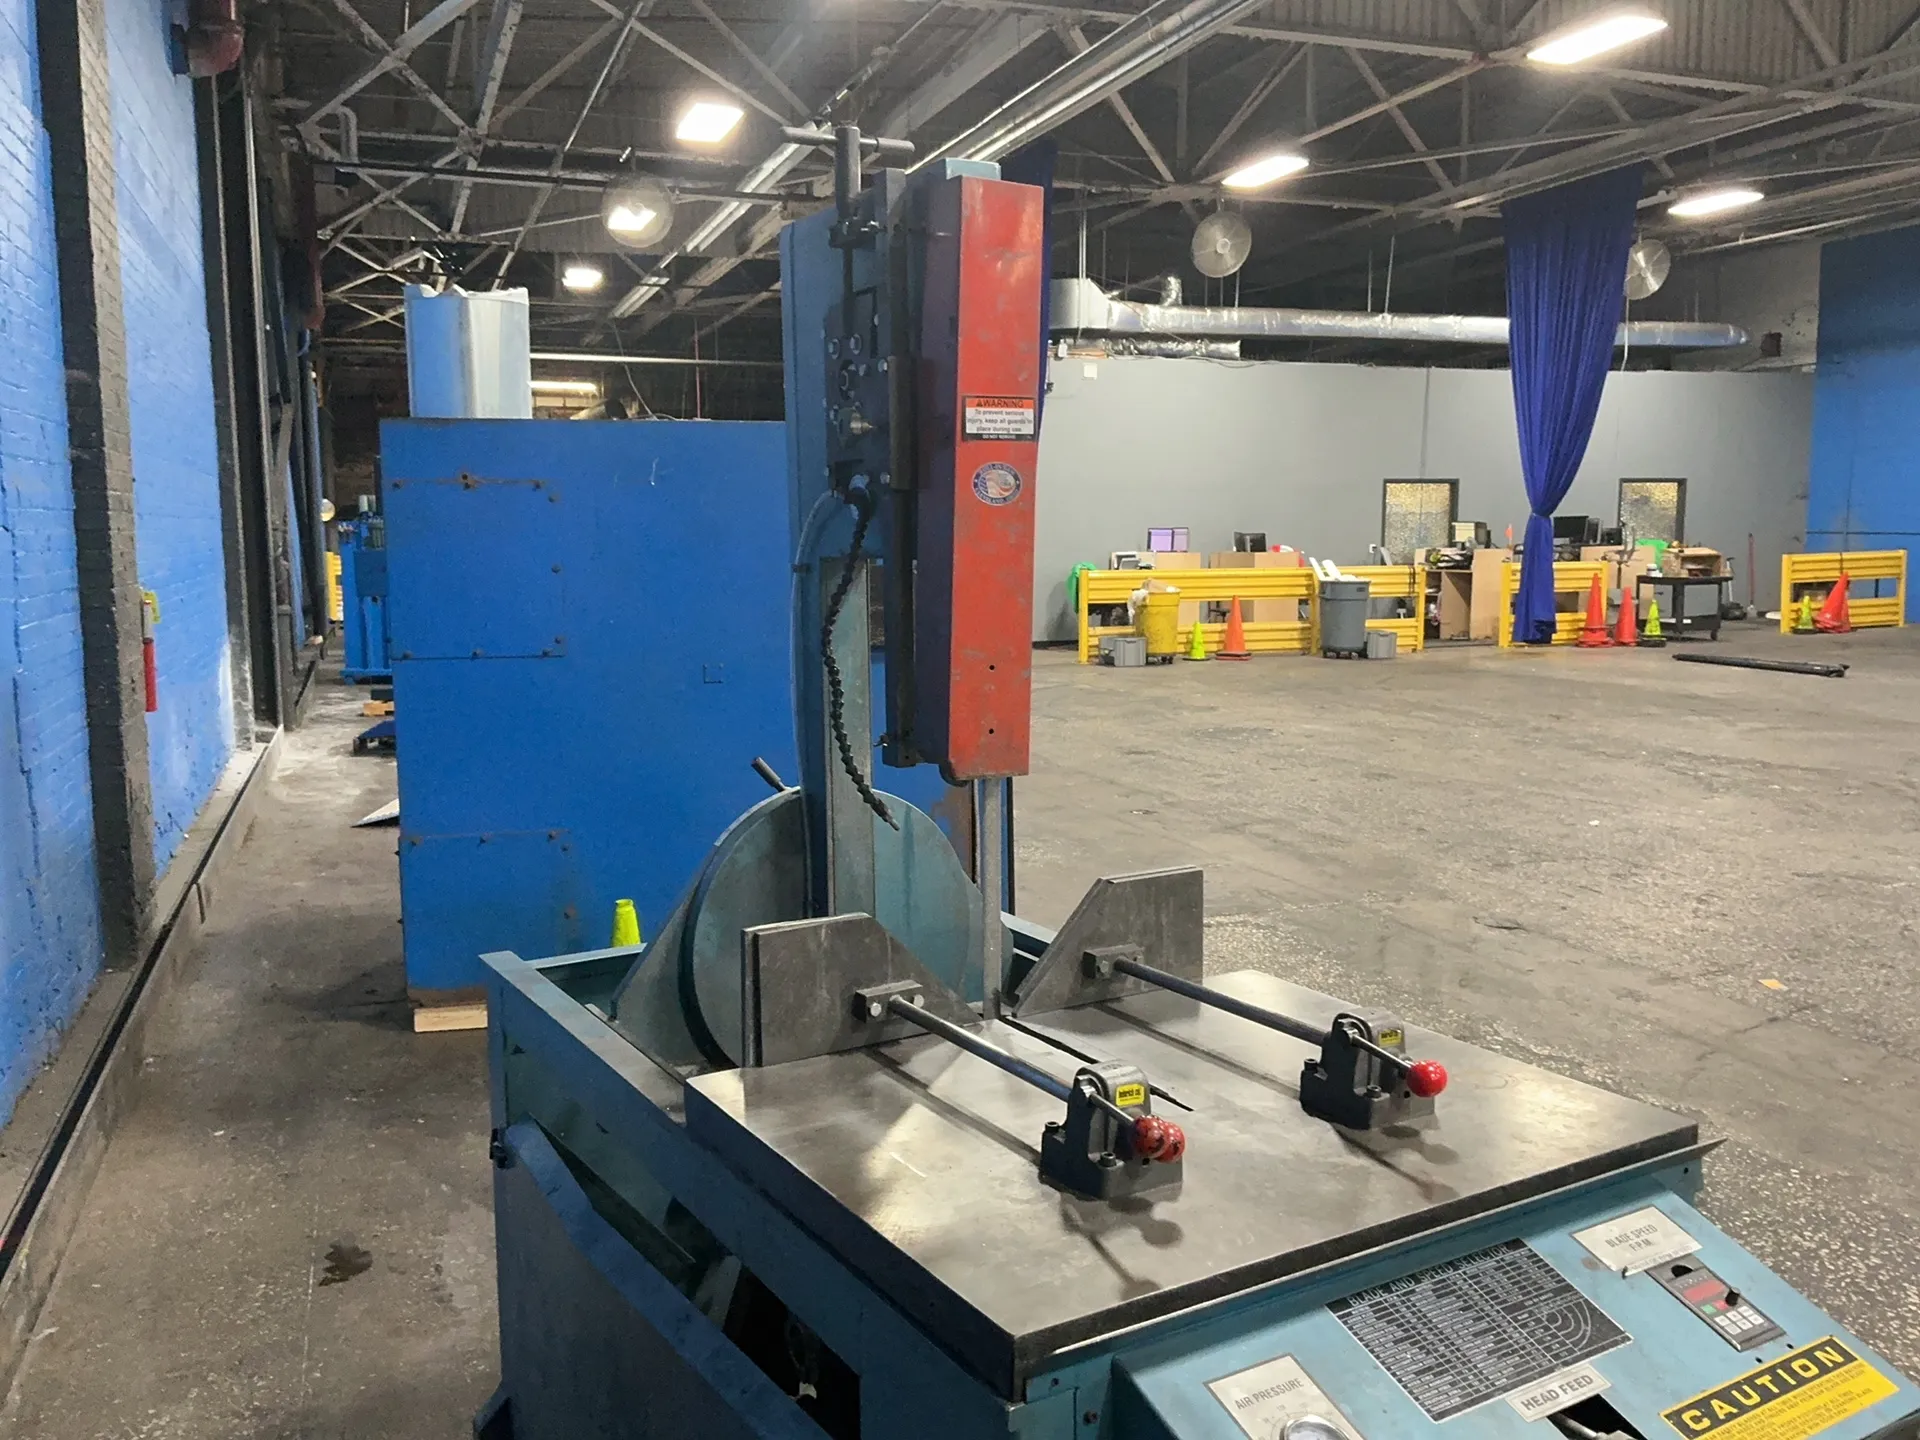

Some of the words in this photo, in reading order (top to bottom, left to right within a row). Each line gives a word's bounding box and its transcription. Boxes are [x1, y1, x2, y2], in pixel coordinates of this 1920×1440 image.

[983, 400, 1024, 408] WARNING
[1604, 1232, 1634, 1247] BLADE
[1628, 1223, 1659, 1238] SPEED
[1345, 1285, 1389, 1306] BLADE
[1386, 1276, 1417, 1292] AND
[1414, 1262, 1456, 1282] SPEED
[1452, 1243, 1513, 1269] SELECTOR
[1235, 1398, 1255, 1409] AIR
[1254, 1378, 1304, 1403] PRESSURE
[1521, 1388, 1559, 1411] HEAD
[1560, 1375, 1594, 1396] FEED
[1681, 1346, 1845, 1431] CAUTION
